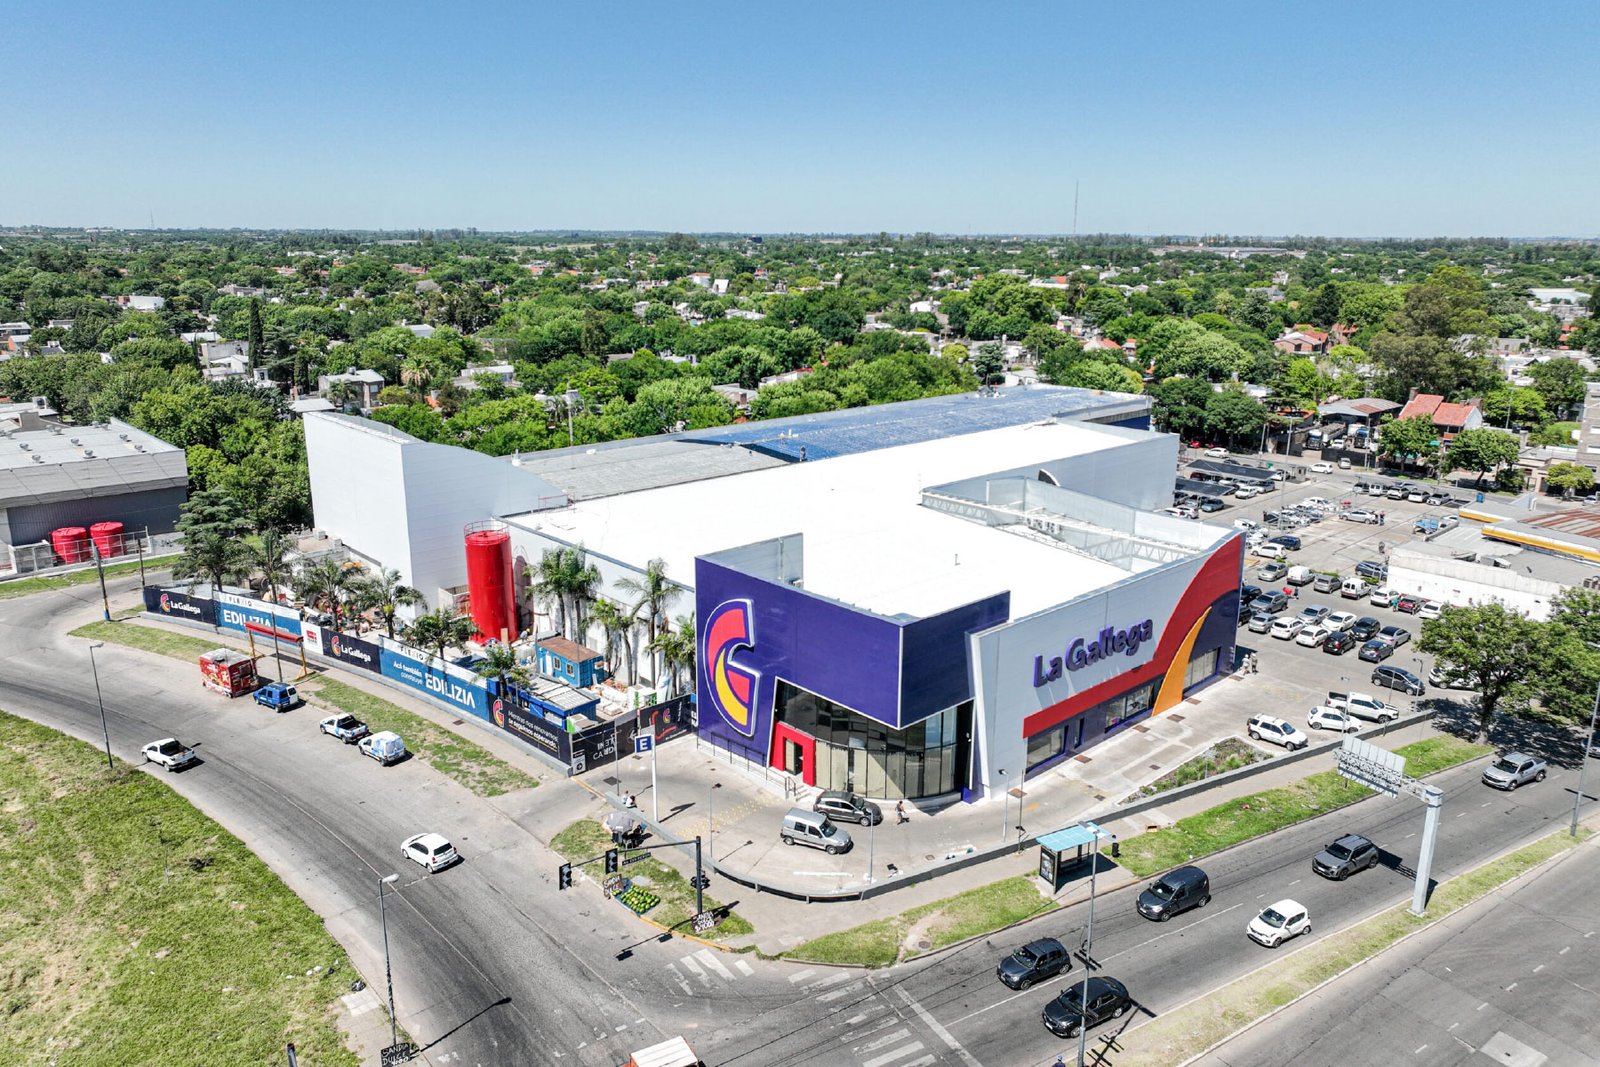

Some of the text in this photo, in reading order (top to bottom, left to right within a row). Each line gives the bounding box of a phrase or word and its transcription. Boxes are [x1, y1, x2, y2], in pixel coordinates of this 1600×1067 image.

[1033, 618, 1153, 688] La Gallega
[424, 672, 476, 709] EDILIZIA
[639, 738, 648, 751] E
